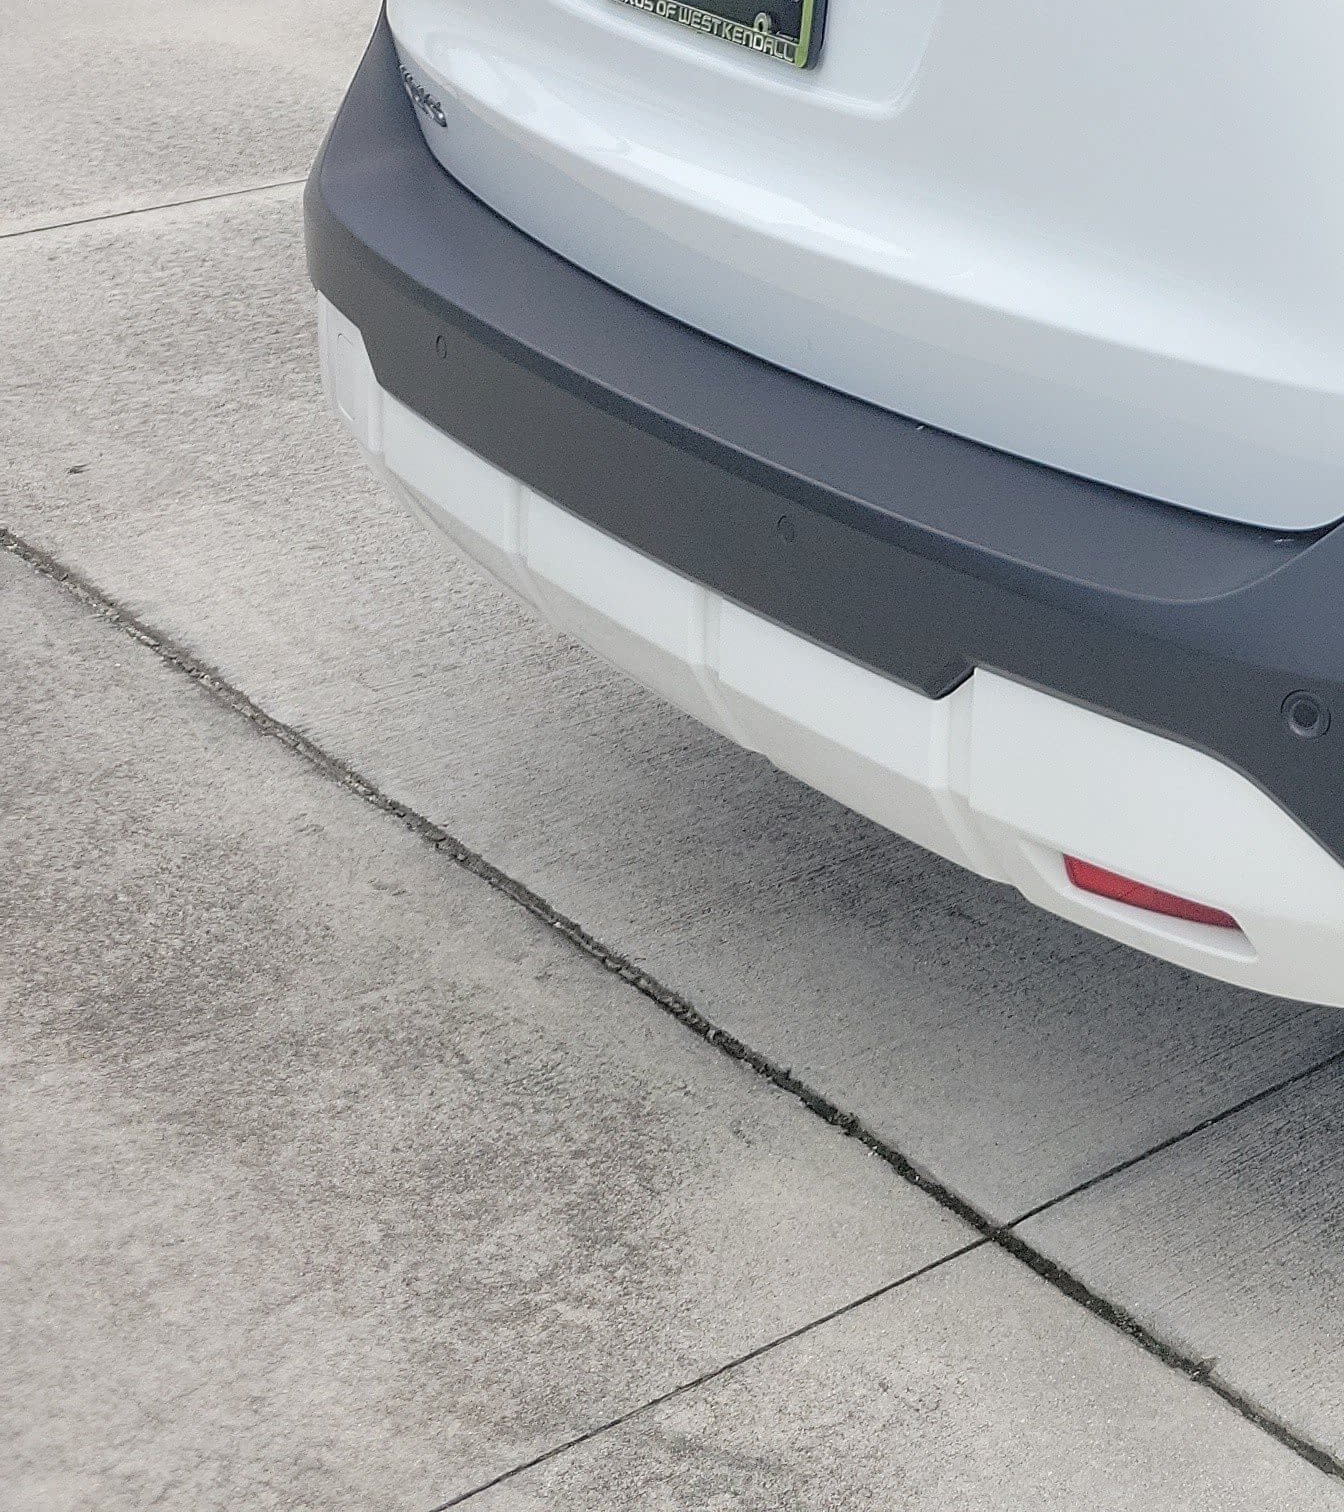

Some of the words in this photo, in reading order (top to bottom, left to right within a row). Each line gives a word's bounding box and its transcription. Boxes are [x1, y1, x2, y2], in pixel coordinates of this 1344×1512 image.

[656, 0, 677, 18] OF
[679, 7, 722, 37] WEST
[721, 21, 795, 63] KENDALL
